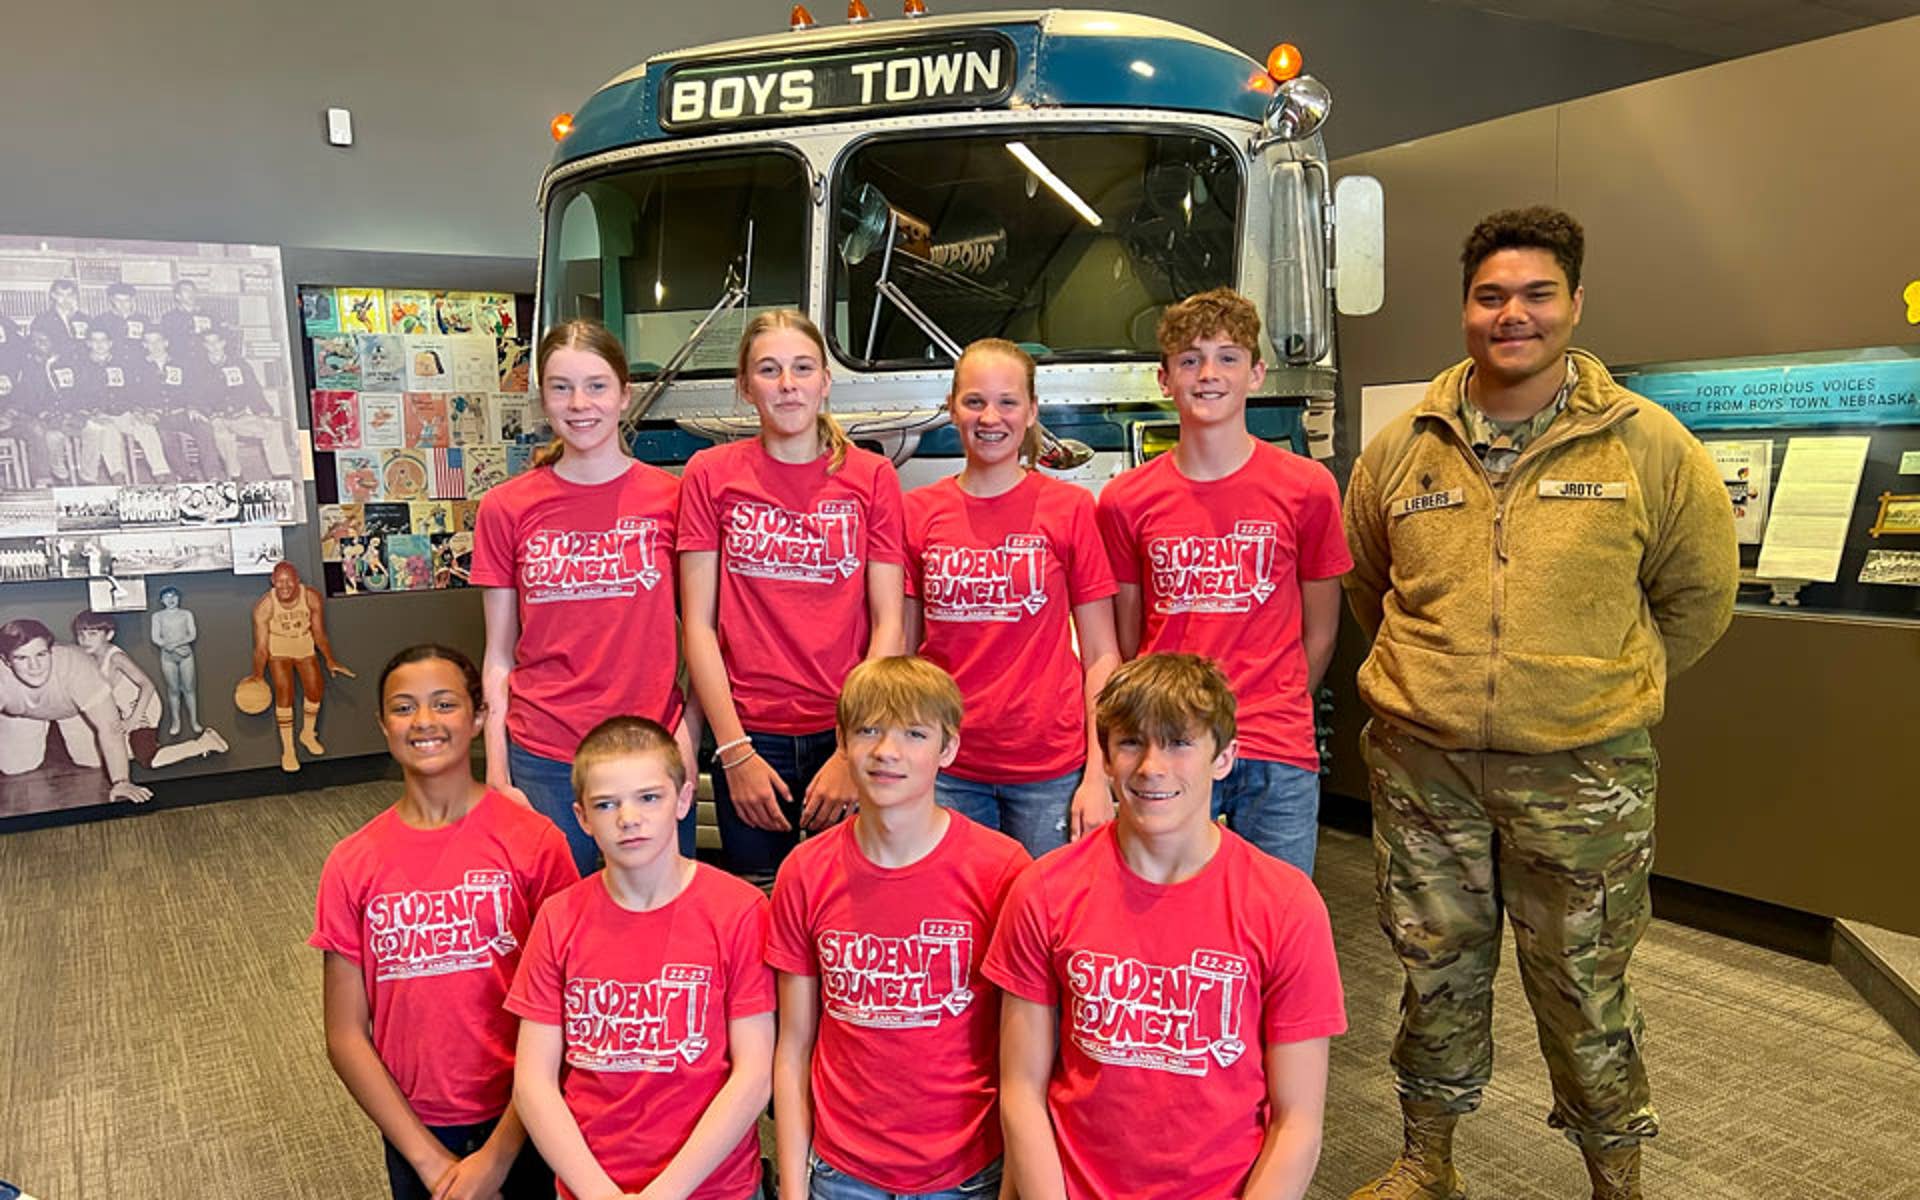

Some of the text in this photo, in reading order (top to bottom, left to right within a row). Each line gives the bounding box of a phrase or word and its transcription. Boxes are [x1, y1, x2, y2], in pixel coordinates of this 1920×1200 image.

[672, 49, 1001, 122] BOYS TOWN
[1696, 377, 1876, 398] FORTY GLORIOUS VOICES
[1706, 399, 1743, 412] FROM
[1750, 396, 1784, 410] BOYS
[1839, 393, 1917, 407] NEBRASKA
[1404, 491, 1450, 511] LIEBERS
[1559, 482, 1604, 497] JROTC
[731, 502, 834, 543] STUDENT
[526, 530, 635, 559] STUDENT
[924, 545, 1024, 578] STUDENT
[1149, 536, 1254, 571] STUDENT
[368, 886, 487, 933] STUDENT
[818, 929, 943, 978] STUDENT
[1199, 955, 1243, 974] 22-23
[1067, 949, 1214, 1016] STUDENT
[564, 977, 683, 1023] STUDENT
